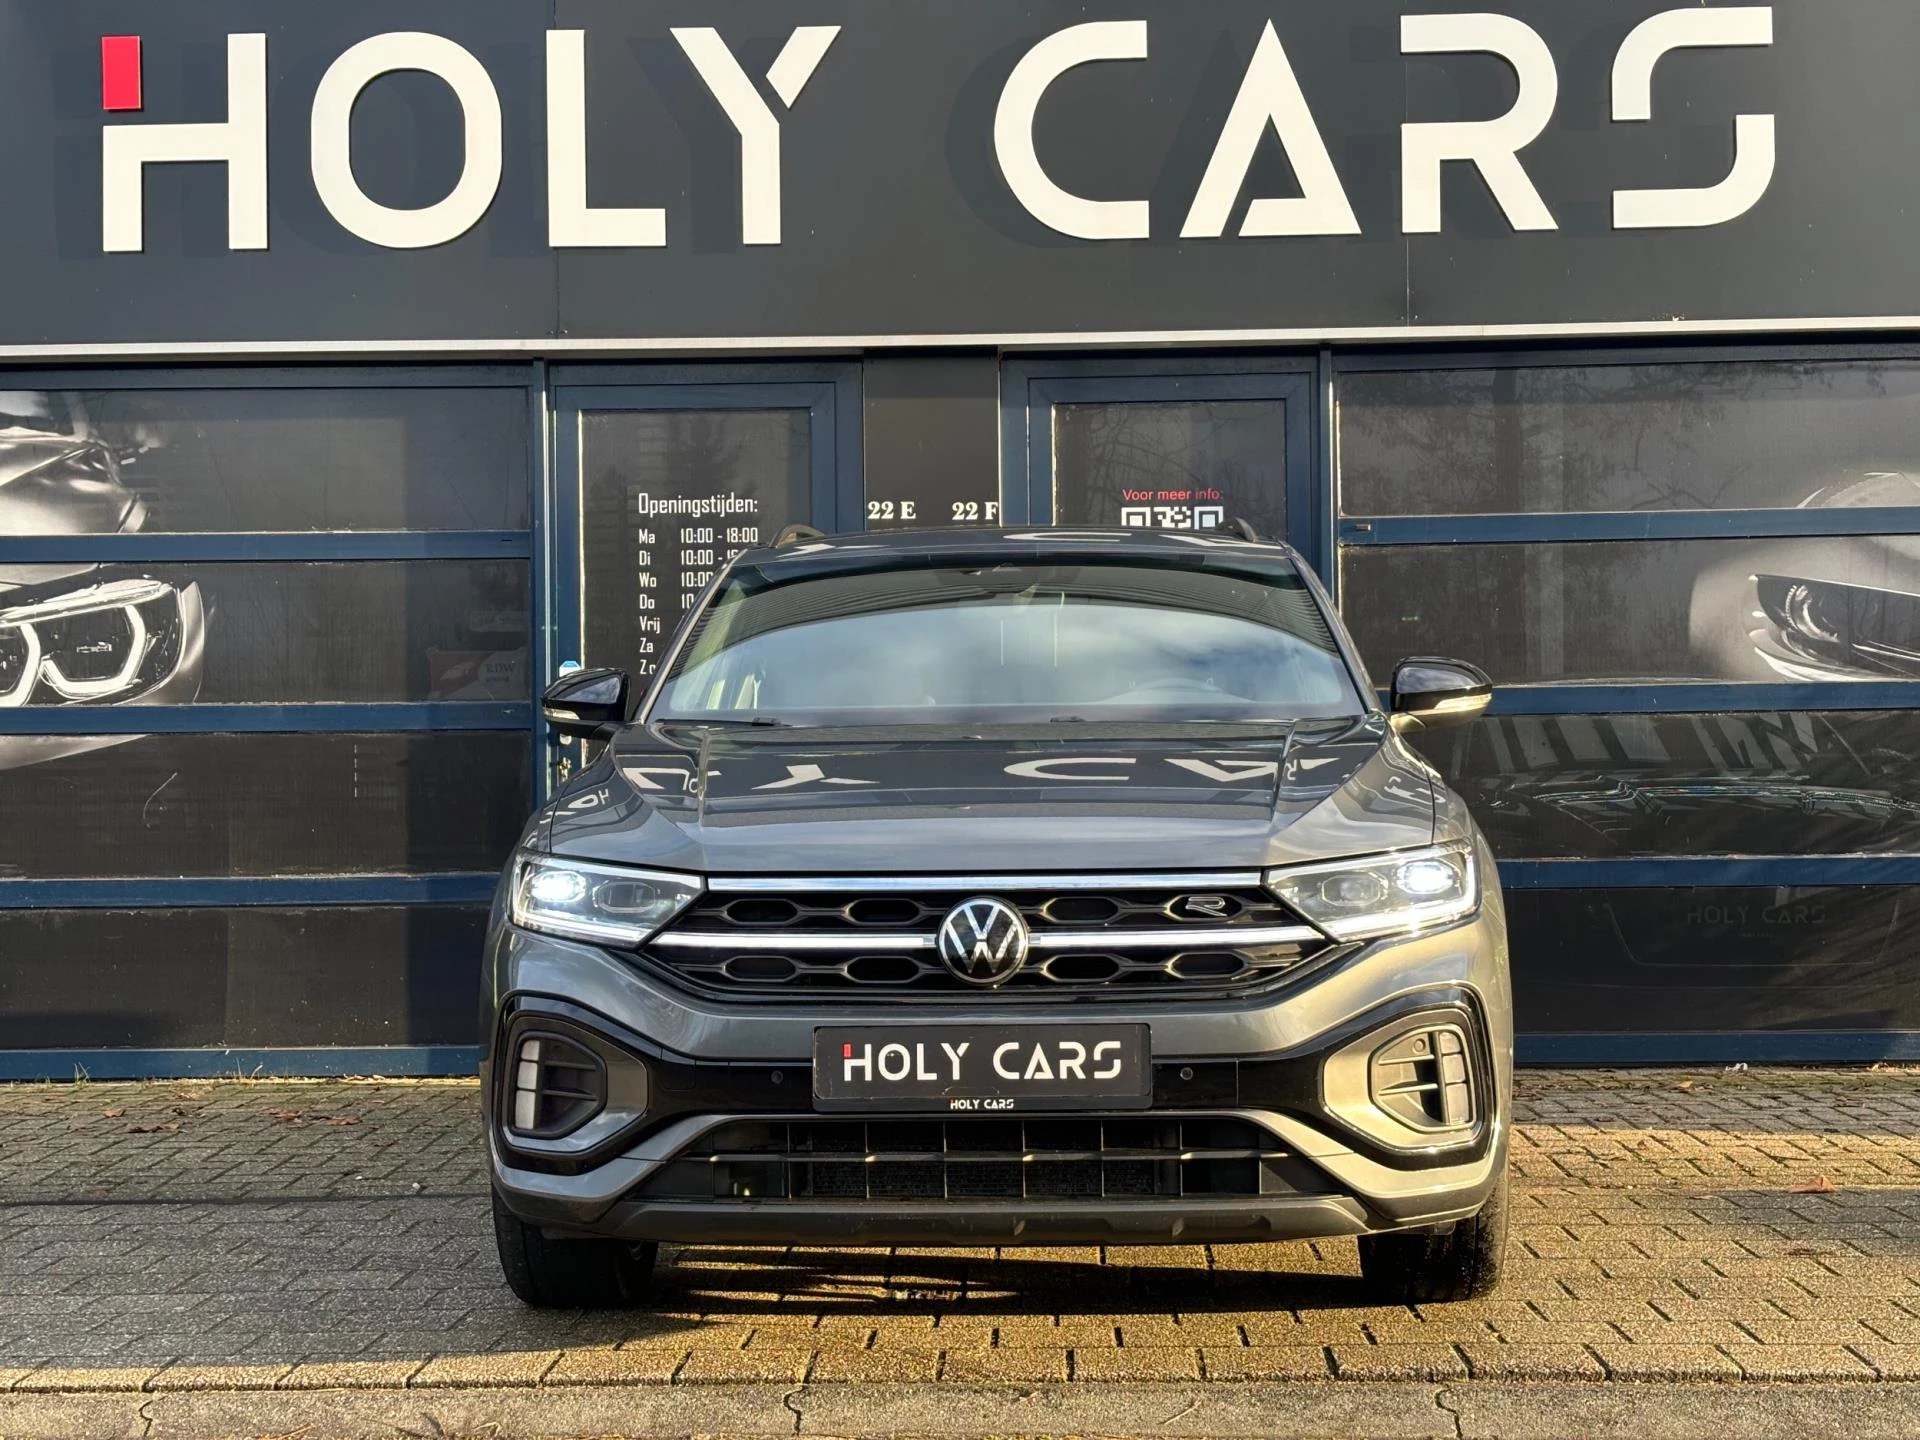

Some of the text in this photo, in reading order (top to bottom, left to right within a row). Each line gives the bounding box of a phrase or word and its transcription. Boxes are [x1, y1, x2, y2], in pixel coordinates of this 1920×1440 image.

[100, 6, 1776, 254] HOLY CARS
[1122, 488, 1223, 501] Voor meer info:
[638, 491, 758, 518] Openingstijden:
[868, 501, 916, 520] 22 E
[952, 501, 998, 521] 22 F
[639, 528, 656, 544] Ma
[681, 527, 713, 543] 10:00
[726, 527, 758, 543] 18:00
[639, 550, 651, 566] Di
[681, 549, 714, 565] 10:00
[639, 572, 657, 588] Wo
[640, 594, 655, 609] Do
[640, 615, 660, 634] Vrij
[640, 637, 654, 653] Za
[486, 662, 516, 673] RDW
[1687, 905, 1826, 925] HOLY CARS
[843, 1040, 1122, 1082] HOLY CARS
[949, 1098, 1014, 1110] HOLY CARS
